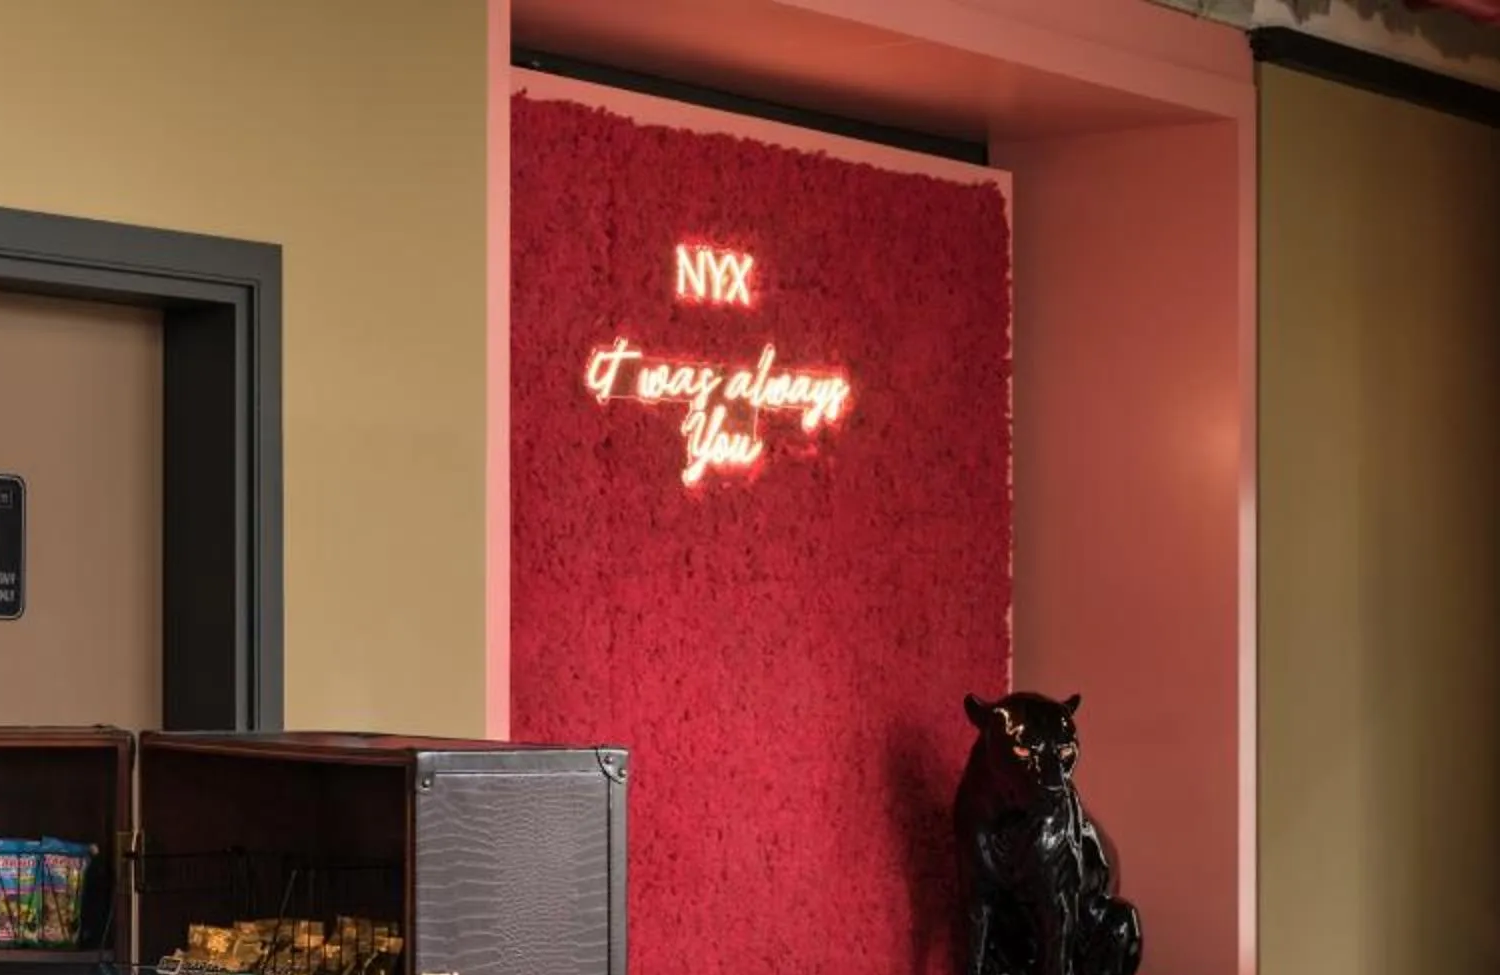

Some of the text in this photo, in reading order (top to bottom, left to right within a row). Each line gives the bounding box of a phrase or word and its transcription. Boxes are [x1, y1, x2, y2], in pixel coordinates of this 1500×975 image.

[675, 245, 753, 304] NYX
[639, 364, 723, 411] was
[724, 344, 849, 428] always
[683, 405, 763, 486] You
